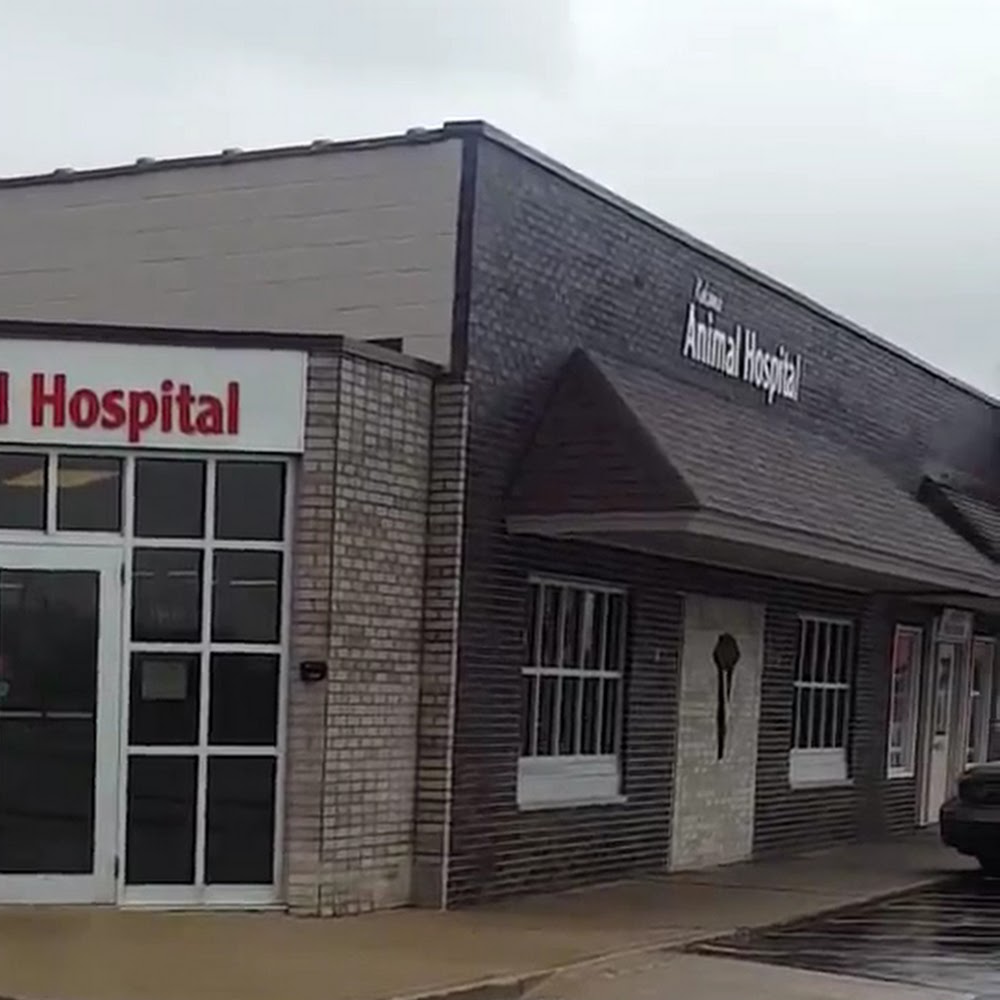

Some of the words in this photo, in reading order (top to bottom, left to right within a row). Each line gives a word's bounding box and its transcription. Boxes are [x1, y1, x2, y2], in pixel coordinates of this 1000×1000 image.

[683, 303, 741, 378] Animal
[743, 329, 801, 404] Hospital
[31, 373, 239, 443] Hospital
